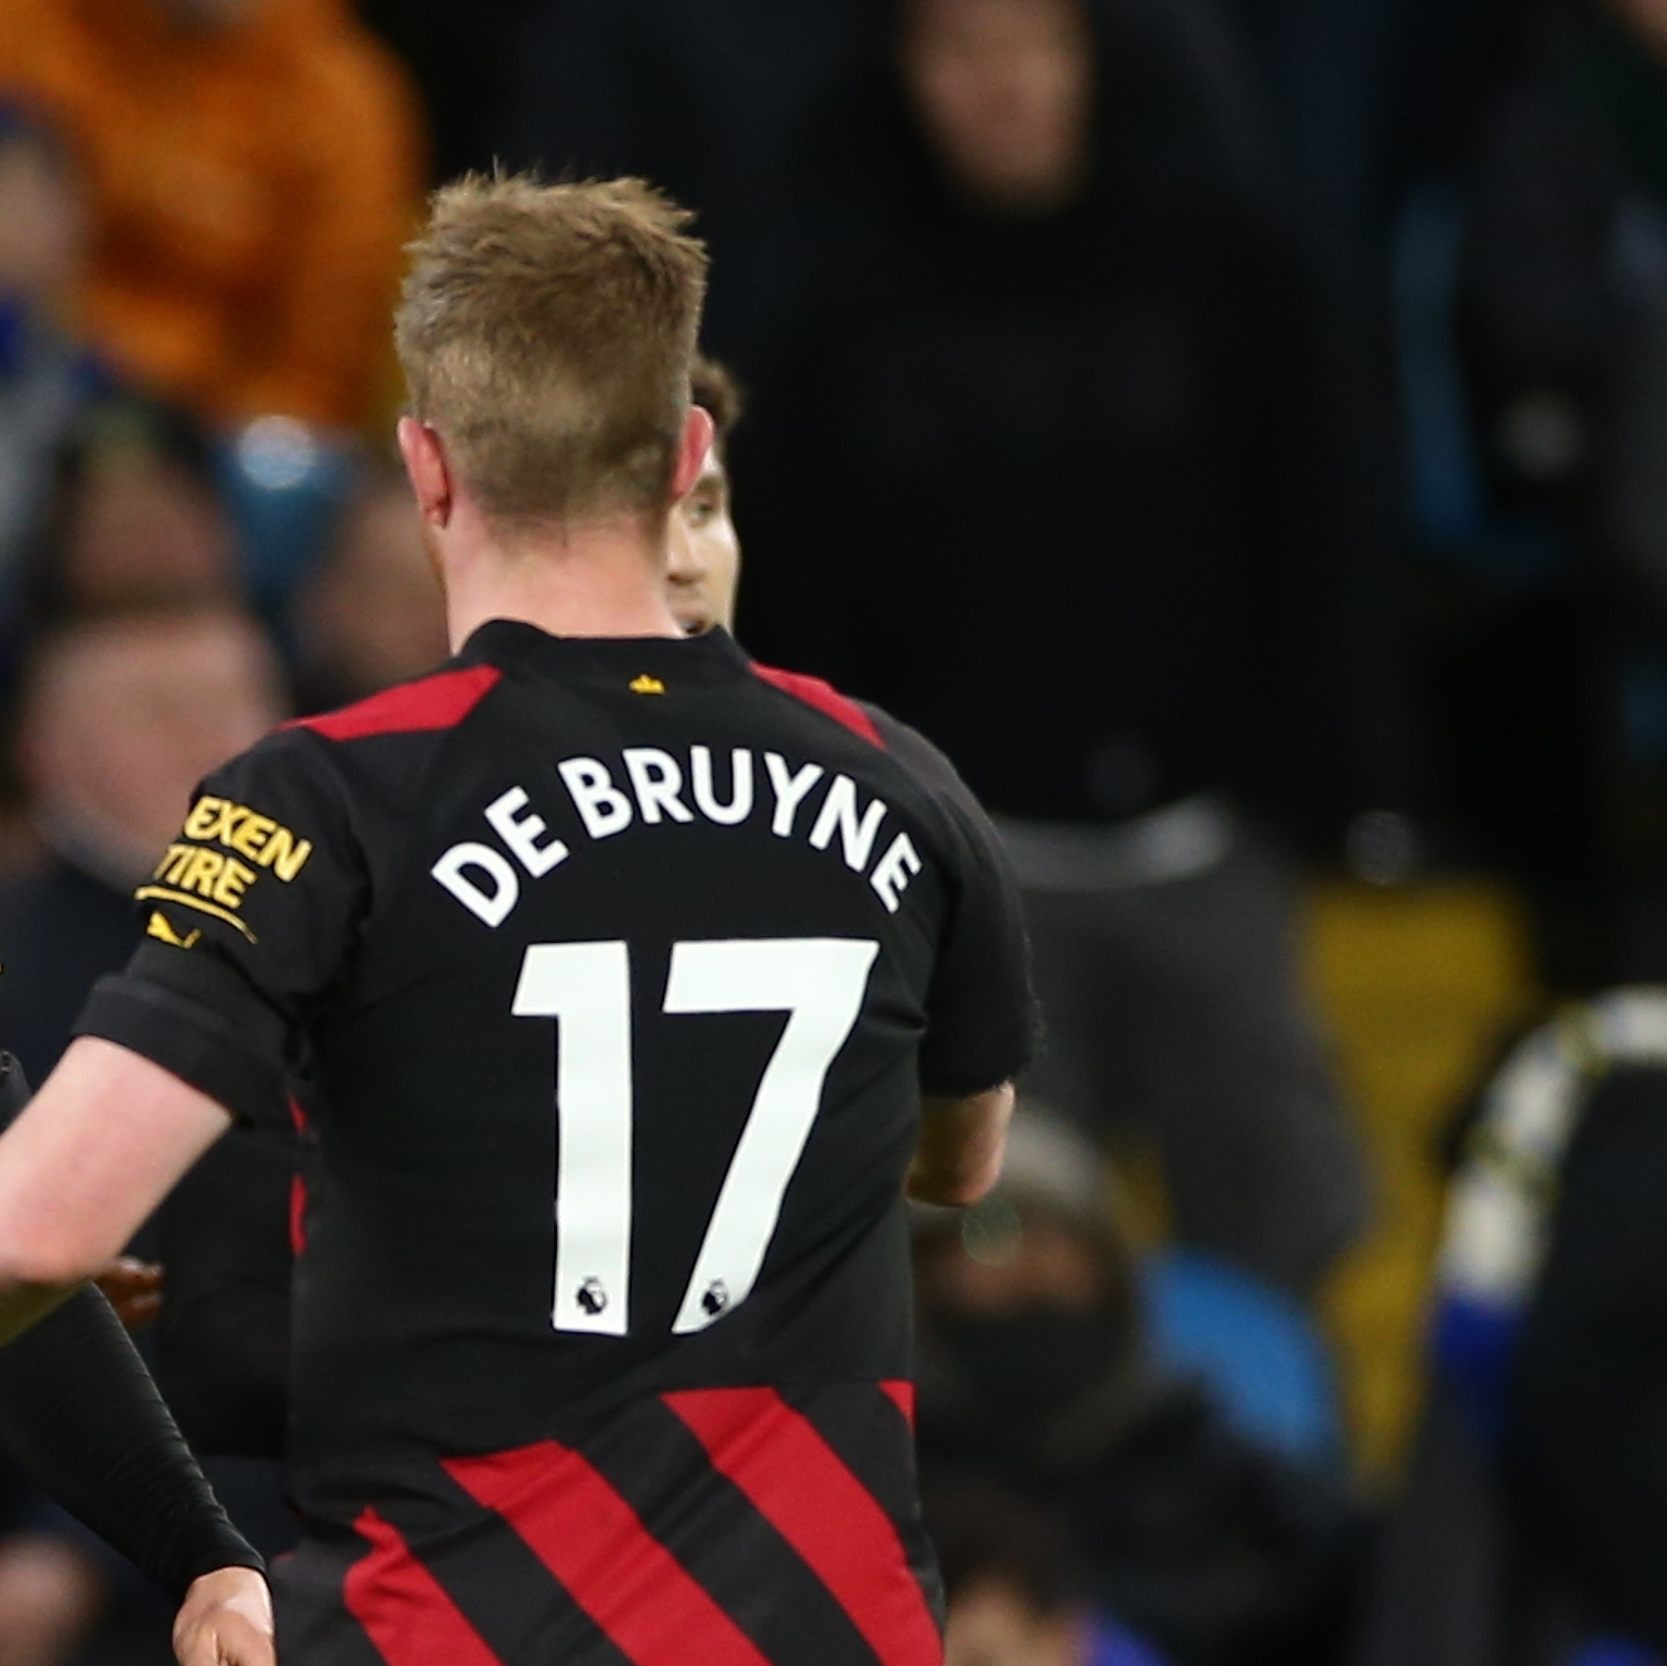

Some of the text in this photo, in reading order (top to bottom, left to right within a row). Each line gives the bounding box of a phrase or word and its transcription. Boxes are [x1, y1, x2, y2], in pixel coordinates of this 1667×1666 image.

[153, 843, 258, 909] TIRE
[184, 795, 312, 883] EXEN
[431, 745, 922, 928] DE BRUYNE
[511, 938, 879, 1336] 17
